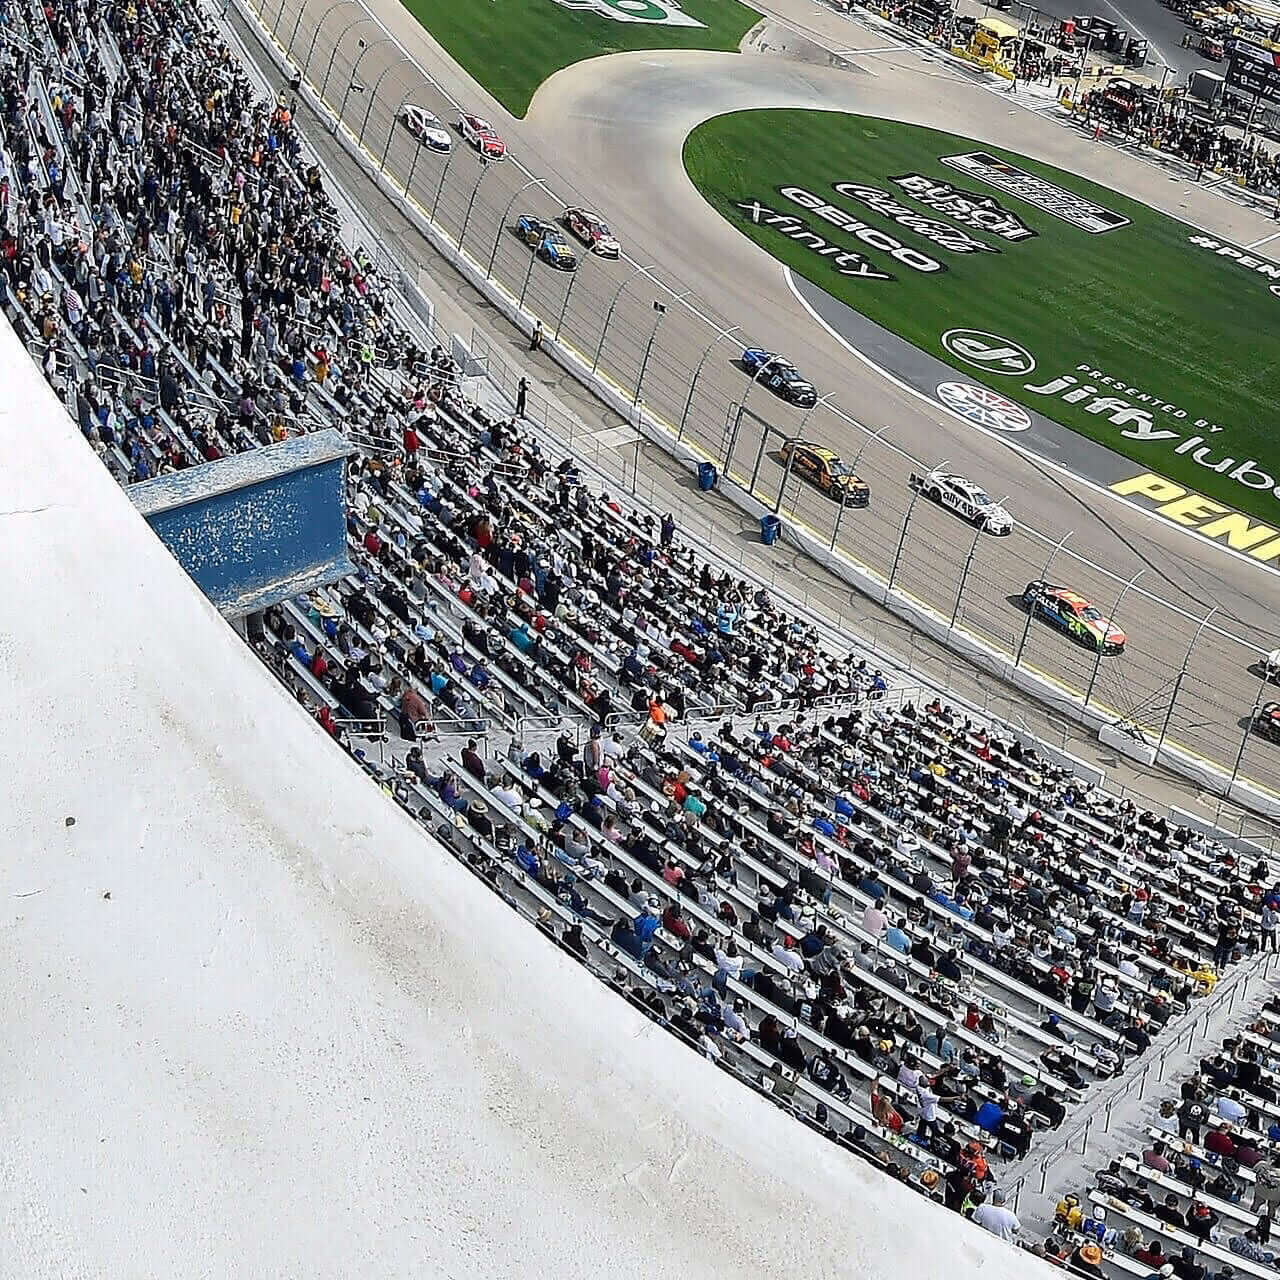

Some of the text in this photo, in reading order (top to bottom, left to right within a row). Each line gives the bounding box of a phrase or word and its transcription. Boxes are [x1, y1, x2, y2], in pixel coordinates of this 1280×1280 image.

[893, 174, 1032, 241] BUSCH
[1014, 174, 1105, 214] NASCAR
[737, 201, 892, 279] xfinity
[780, 186, 942, 272] GEICO
[1023, 374, 1181, 441] jiffy
[1076, 363, 1225, 434] PRESENTED BY
